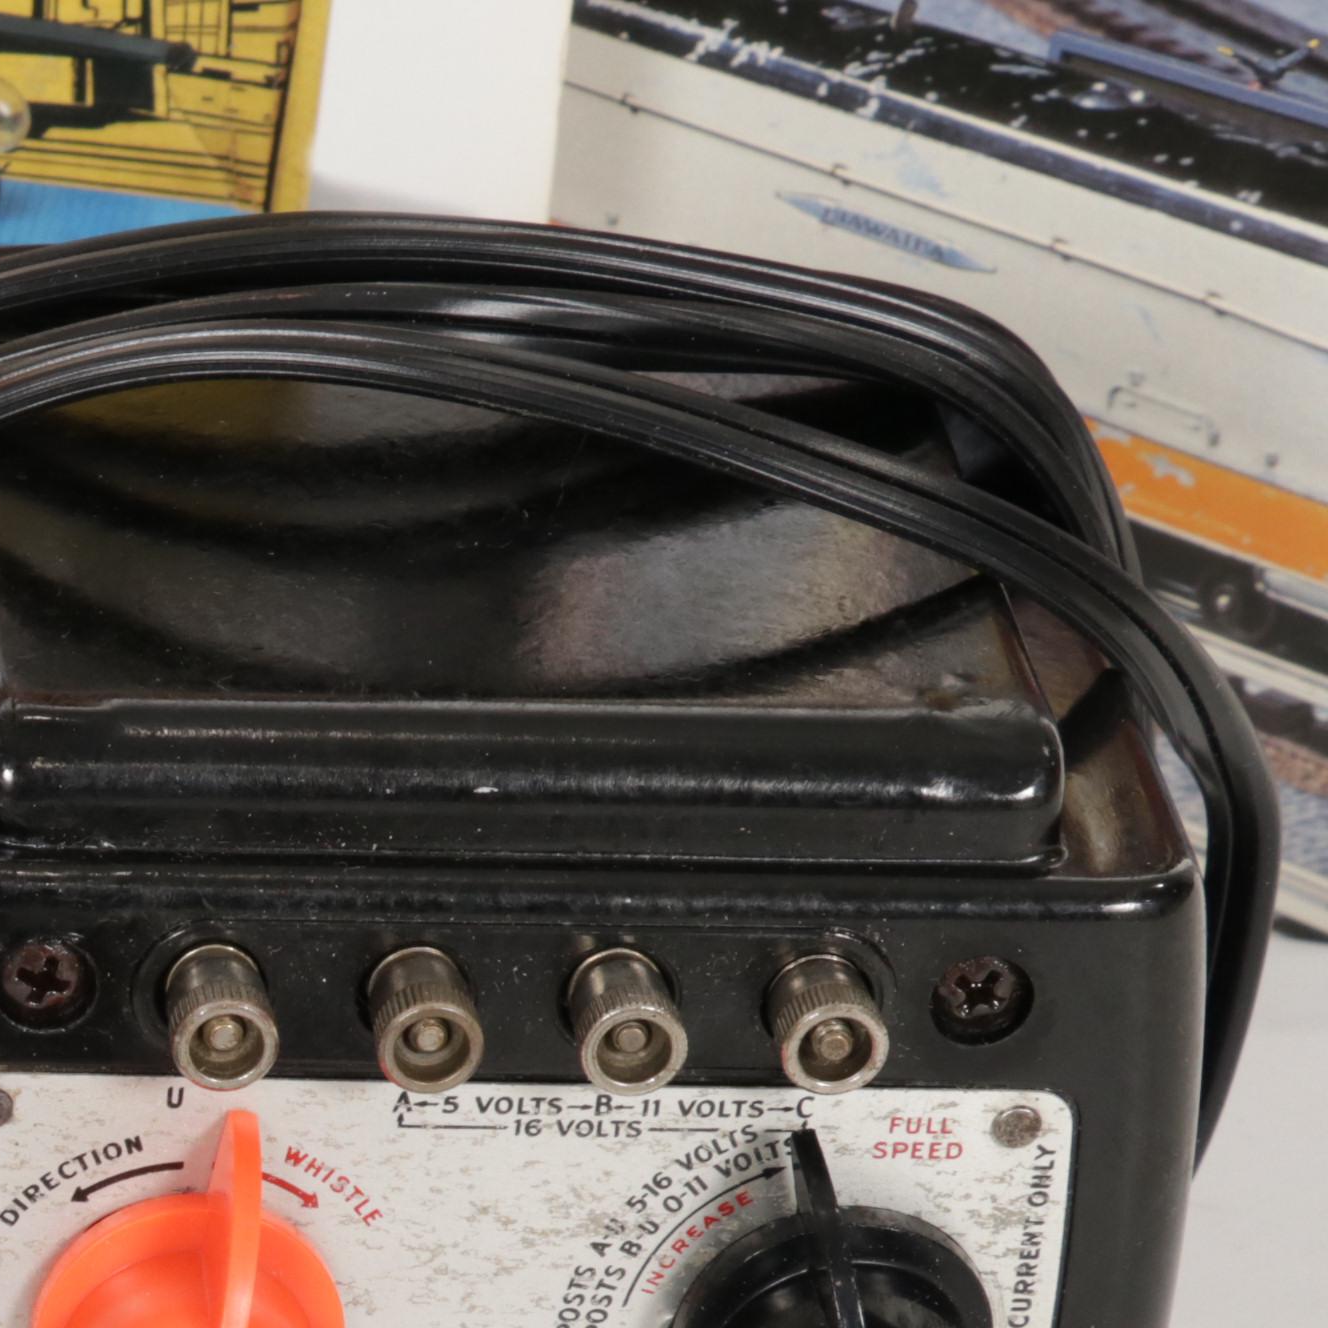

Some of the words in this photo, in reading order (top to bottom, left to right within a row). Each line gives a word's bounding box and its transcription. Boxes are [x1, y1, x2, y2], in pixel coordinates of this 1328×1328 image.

[166, 1087, 184, 1110] U
[393, 1091, 414, 1113] A
[441, 1096, 459, 1114] 5
[475, 1096, 563, 1116] VOLTS
[594, 1094, 614, 1115] B
[642, 1098, 661, 1117] 11
[679, 1099, 765, 1119] VOLTS
[795, 1096, 816, 1119] C
[513, 1119, 542, 1137] 16
[556, 1119, 643, 1138] VOLTS
[888, 1116, 954, 1135] FULL
[626, 1171, 674, 1214] 5-16
[676, 1124, 760, 1174] VOLTS
[872, 1141, 964, 1161] SPEED
[285, 1145, 386, 1229] WHISTLE
[1031, 1145, 1057, 1209] ONLY
[619, 1220, 659, 1259] B-U
[663, 1176, 710, 1215] 0-11
[641, 1190, 755, 1296] INCREASE
